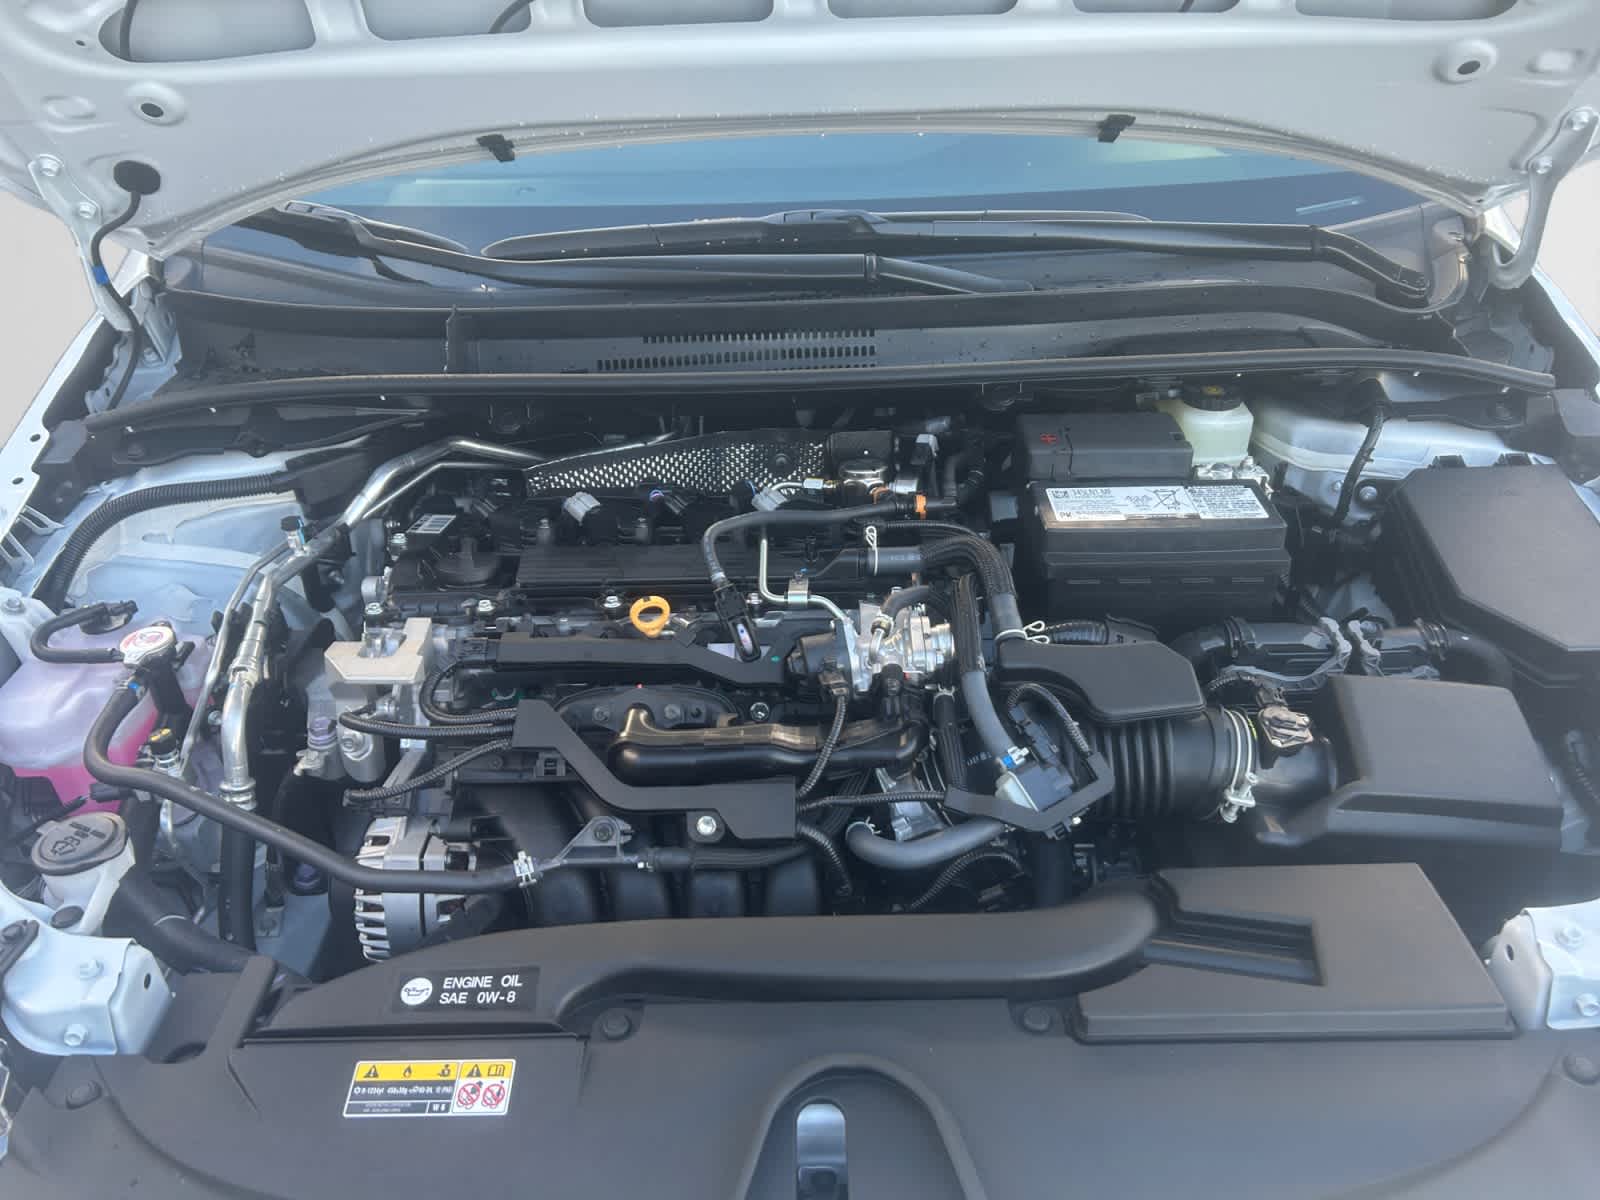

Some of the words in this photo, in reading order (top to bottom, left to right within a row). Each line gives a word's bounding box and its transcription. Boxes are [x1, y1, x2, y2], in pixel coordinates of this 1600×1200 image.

[443, 975, 493, 989] ENGINE
[501, 974, 523, 987] OIL
[439, 992, 468, 1004] SAE
[477, 991, 516, 1003] 0W-8
